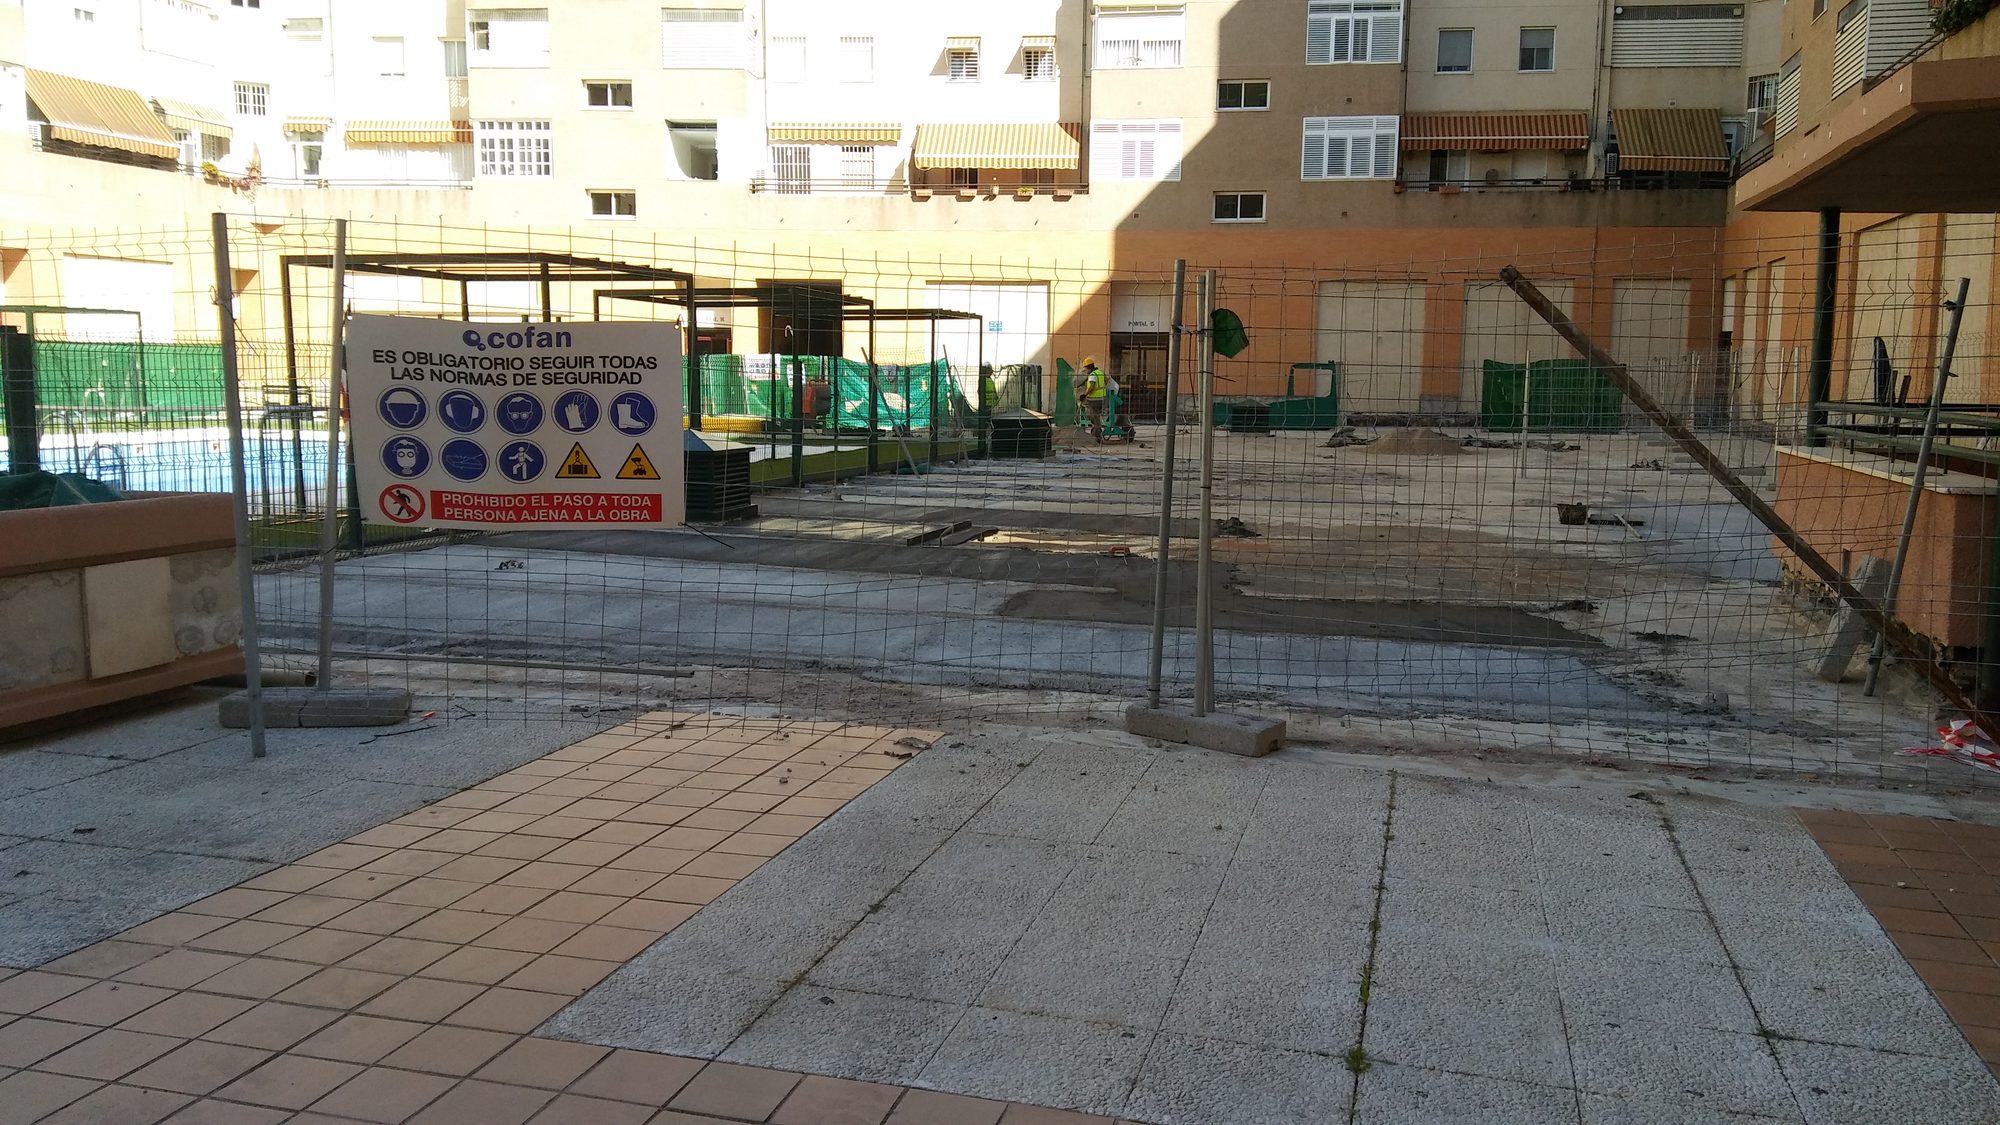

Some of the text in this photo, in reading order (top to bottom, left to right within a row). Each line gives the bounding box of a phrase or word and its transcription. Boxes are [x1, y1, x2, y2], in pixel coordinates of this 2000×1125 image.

[372, 349, 657, 370] ES OBLIGATORIO SEGUIR TODAS
[391, 366, 642, 387] LAS NORMAS DE SEGURIDAD
[442, 493, 651, 507] PROHIBIDO EL PASO A TODA
[444, 507, 650, 521] PERSONA AJENA A LA OBRA
